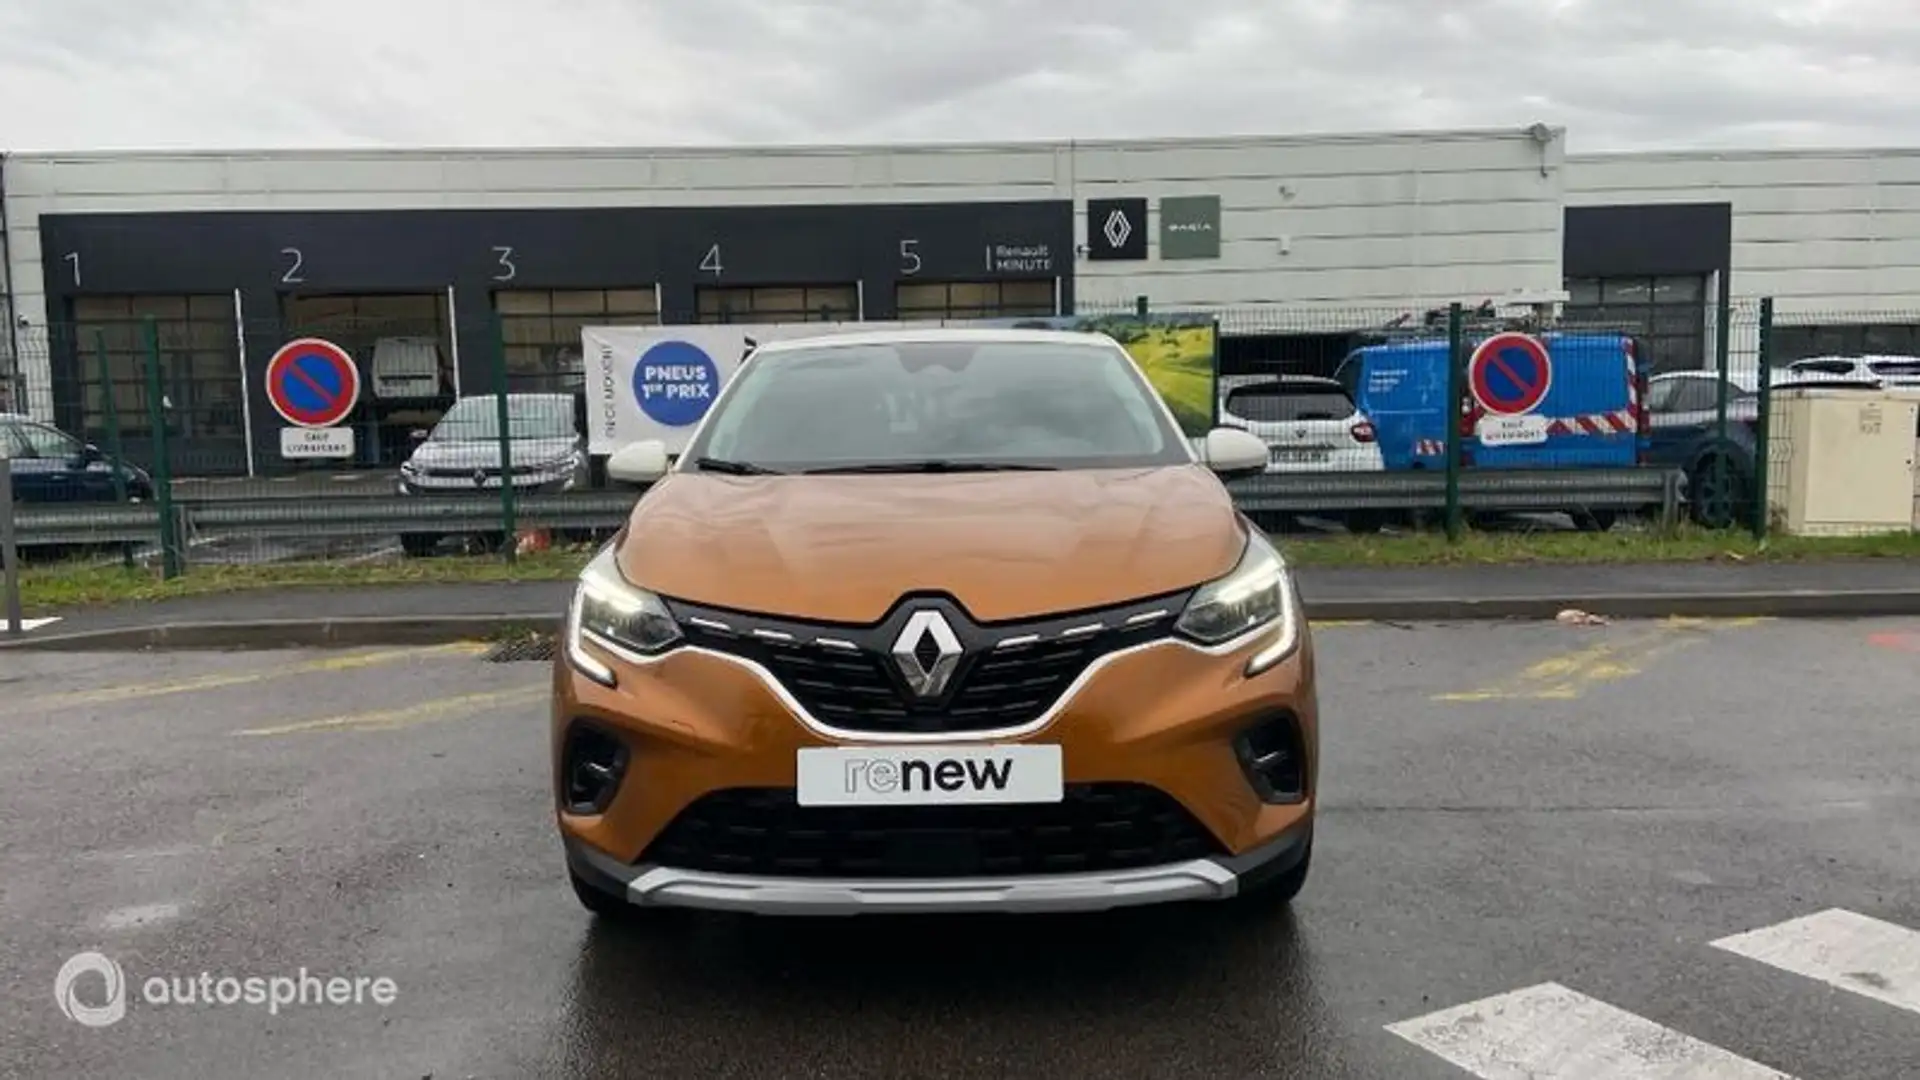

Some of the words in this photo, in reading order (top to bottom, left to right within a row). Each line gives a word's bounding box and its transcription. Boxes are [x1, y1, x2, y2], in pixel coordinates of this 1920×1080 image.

[65, 252, 81, 286] 1
[280, 247, 304, 283] 2
[492, 246, 516, 280] 3
[699, 243, 724, 276] 4
[900, 240, 922, 274] 5
[996, 258, 1053, 271] MINUTE
[645, 364, 707, 381] PNEUS
[666, 383, 711, 400] PRIX
[844, 758, 1013, 793] renew
